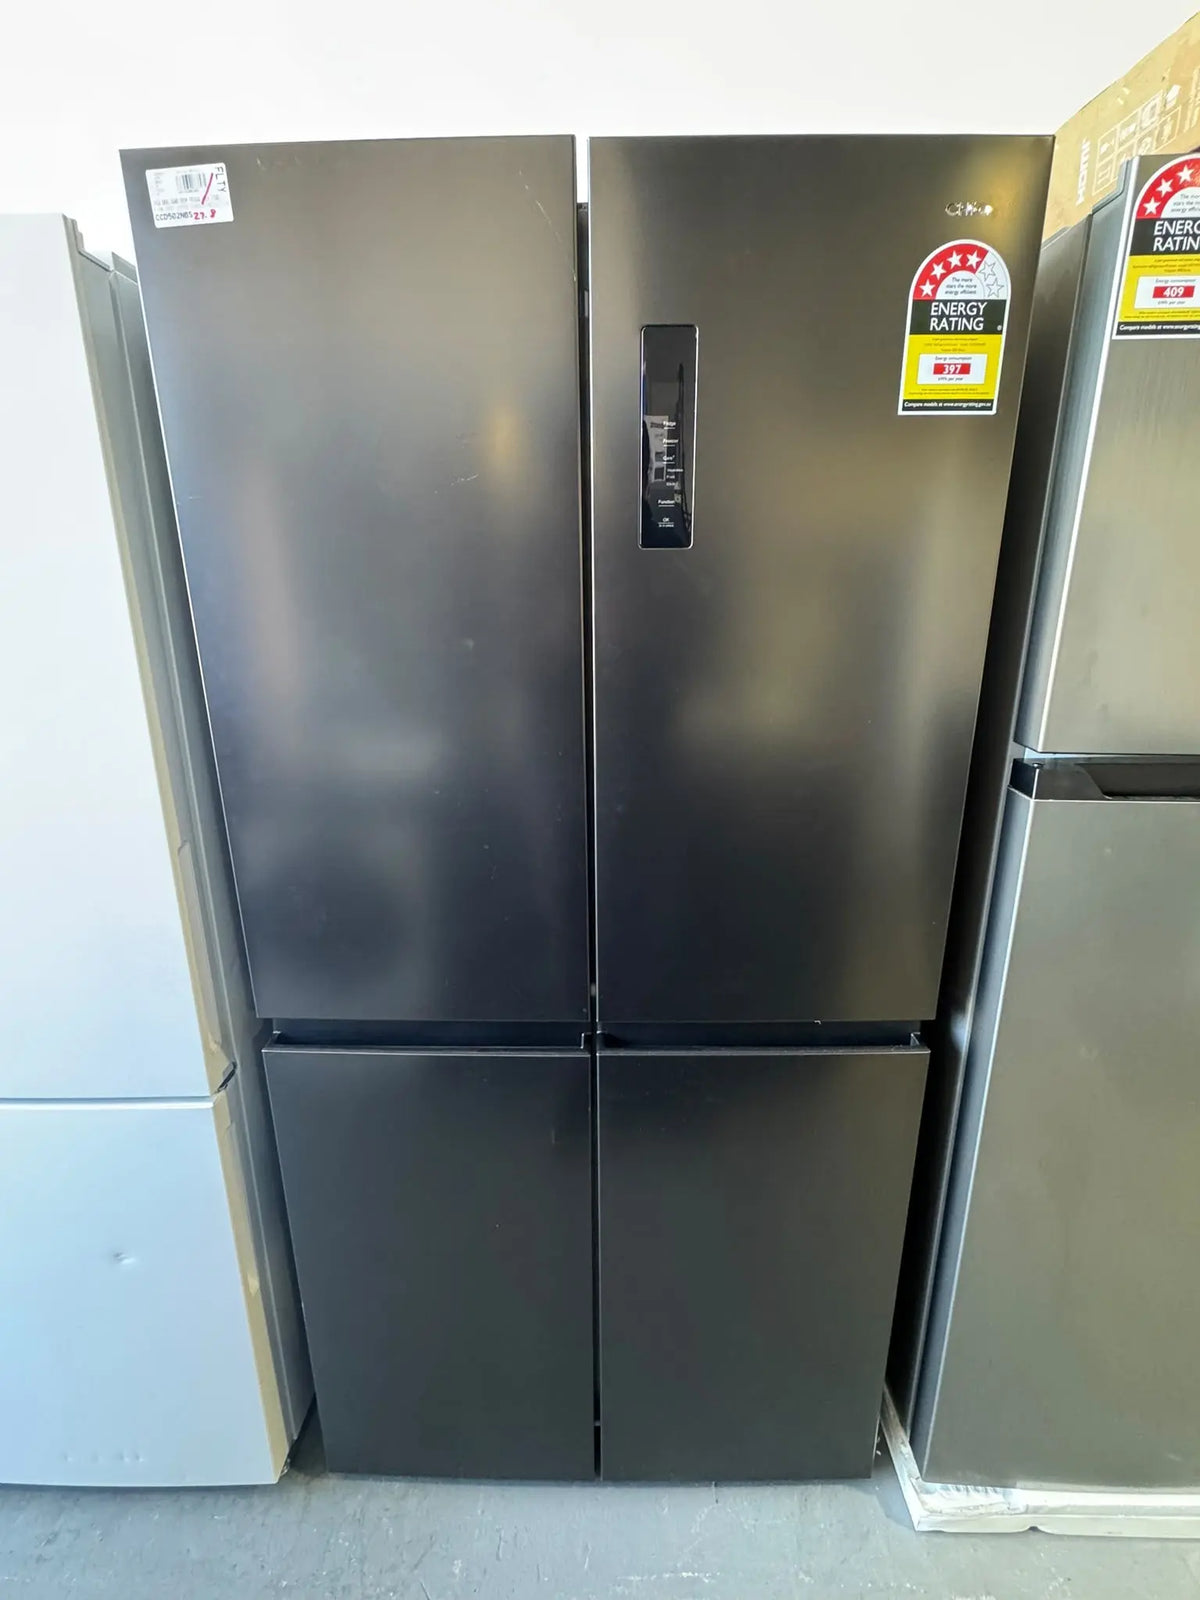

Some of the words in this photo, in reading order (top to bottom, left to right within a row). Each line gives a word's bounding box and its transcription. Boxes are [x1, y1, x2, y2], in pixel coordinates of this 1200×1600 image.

[1163, 286, 1185, 297] 409
[930, 301, 988, 317] ENERGY
[929, 317, 985, 332] RATING
[943, 364, 962, 374] 397
